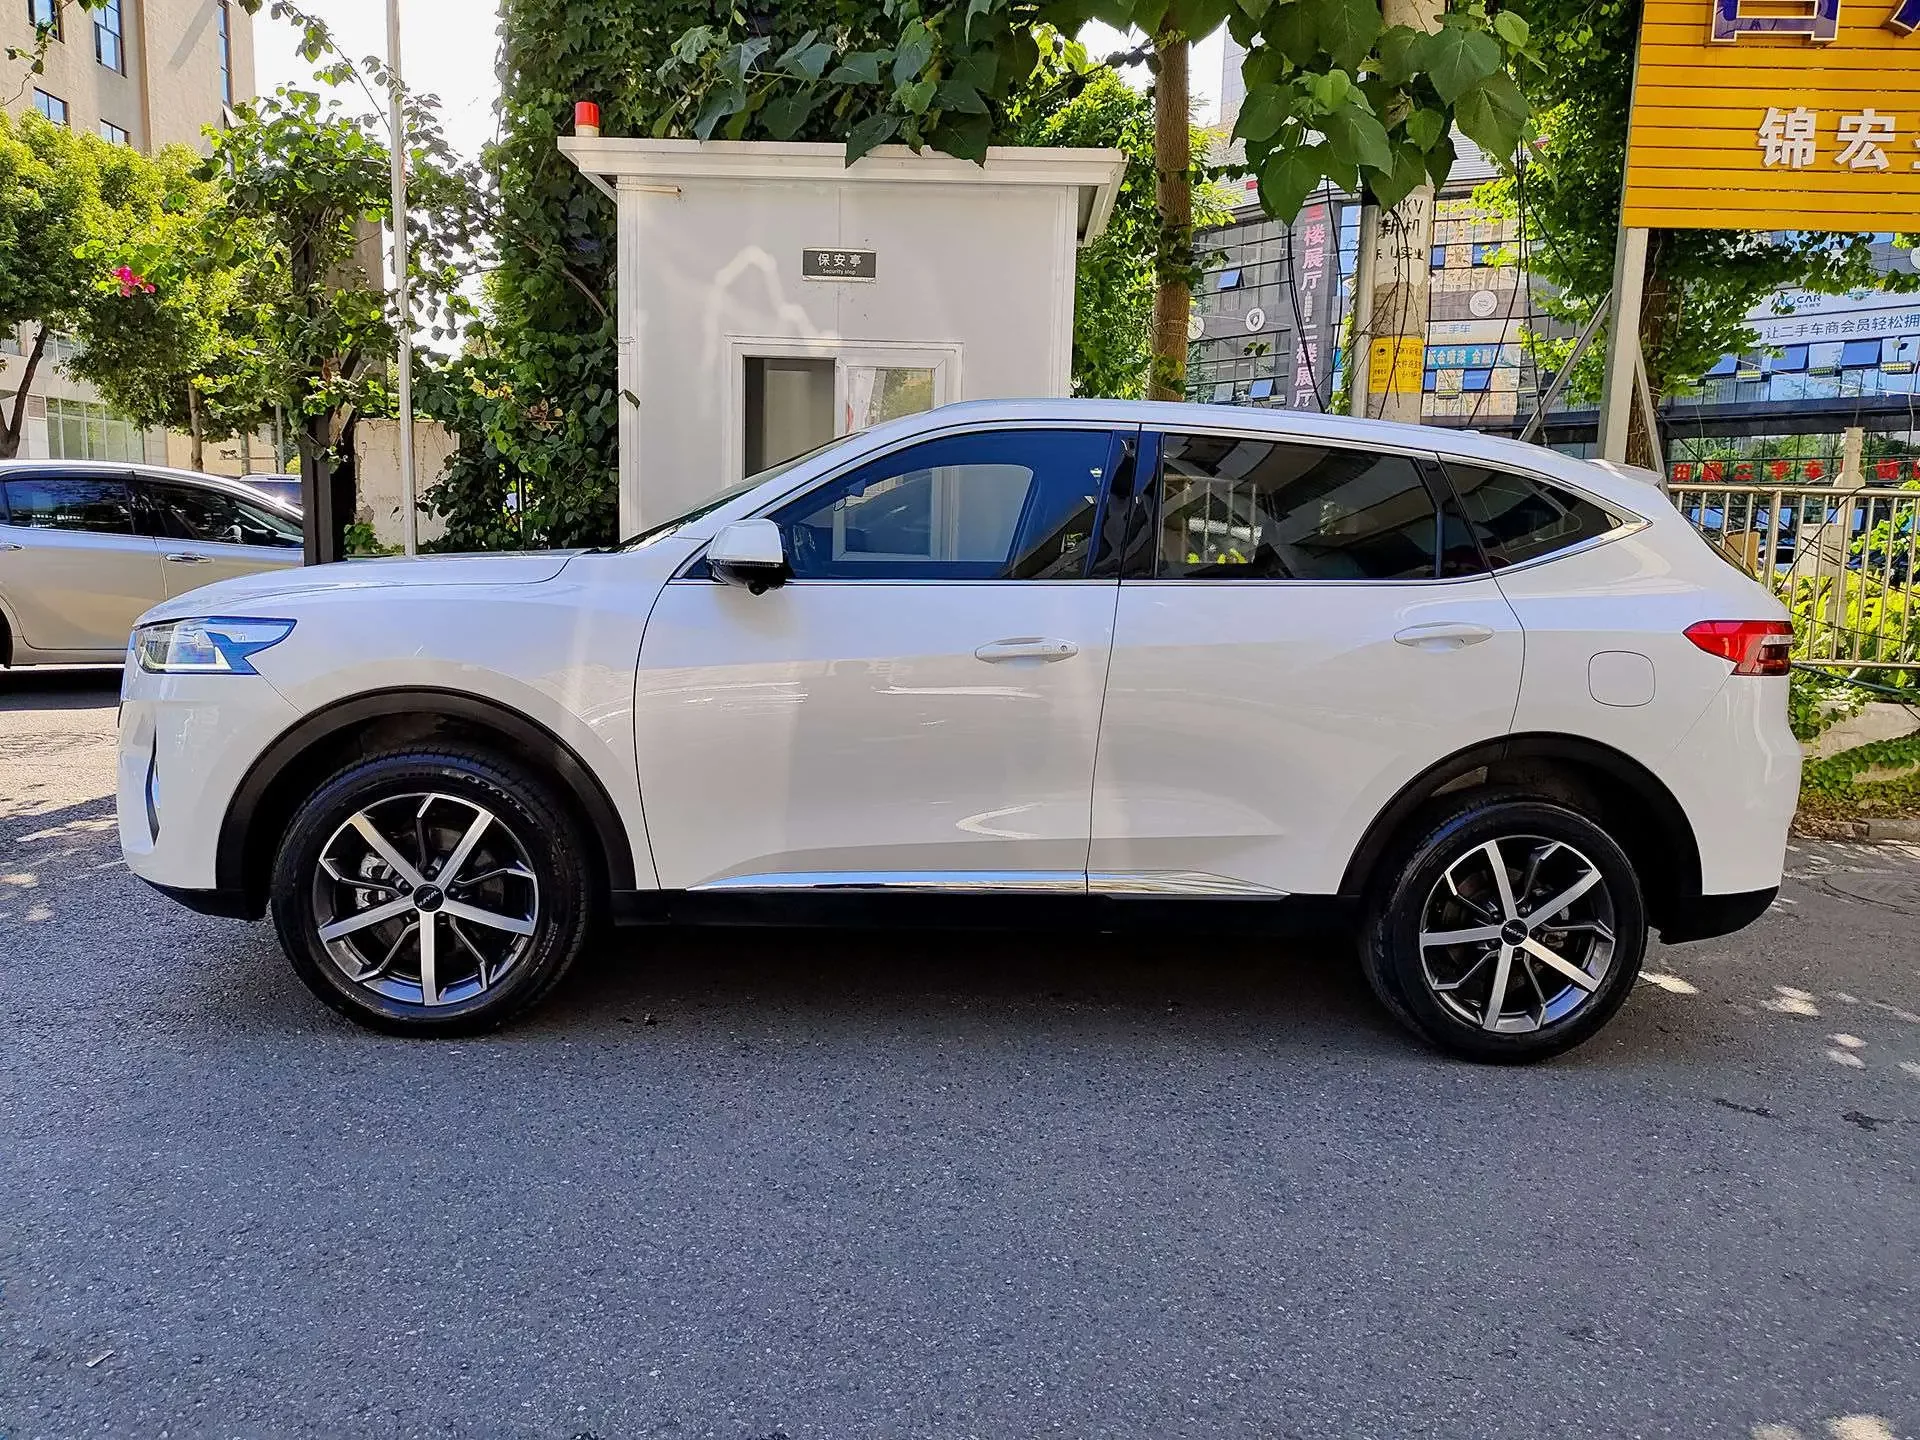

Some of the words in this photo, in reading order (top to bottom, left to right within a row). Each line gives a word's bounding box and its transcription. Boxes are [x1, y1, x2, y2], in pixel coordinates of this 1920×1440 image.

[1758, 106, 1920, 170] 锦宏
[1398, 199, 1424, 214] KV
[817, 253, 861, 267] 保安亭
[1302, 203, 1325, 291] 三楼展厅
[1766, 313, 1920, 339] 让二手车商会员轻松拥
[1293, 324, 1318, 408] 二楼展厅
